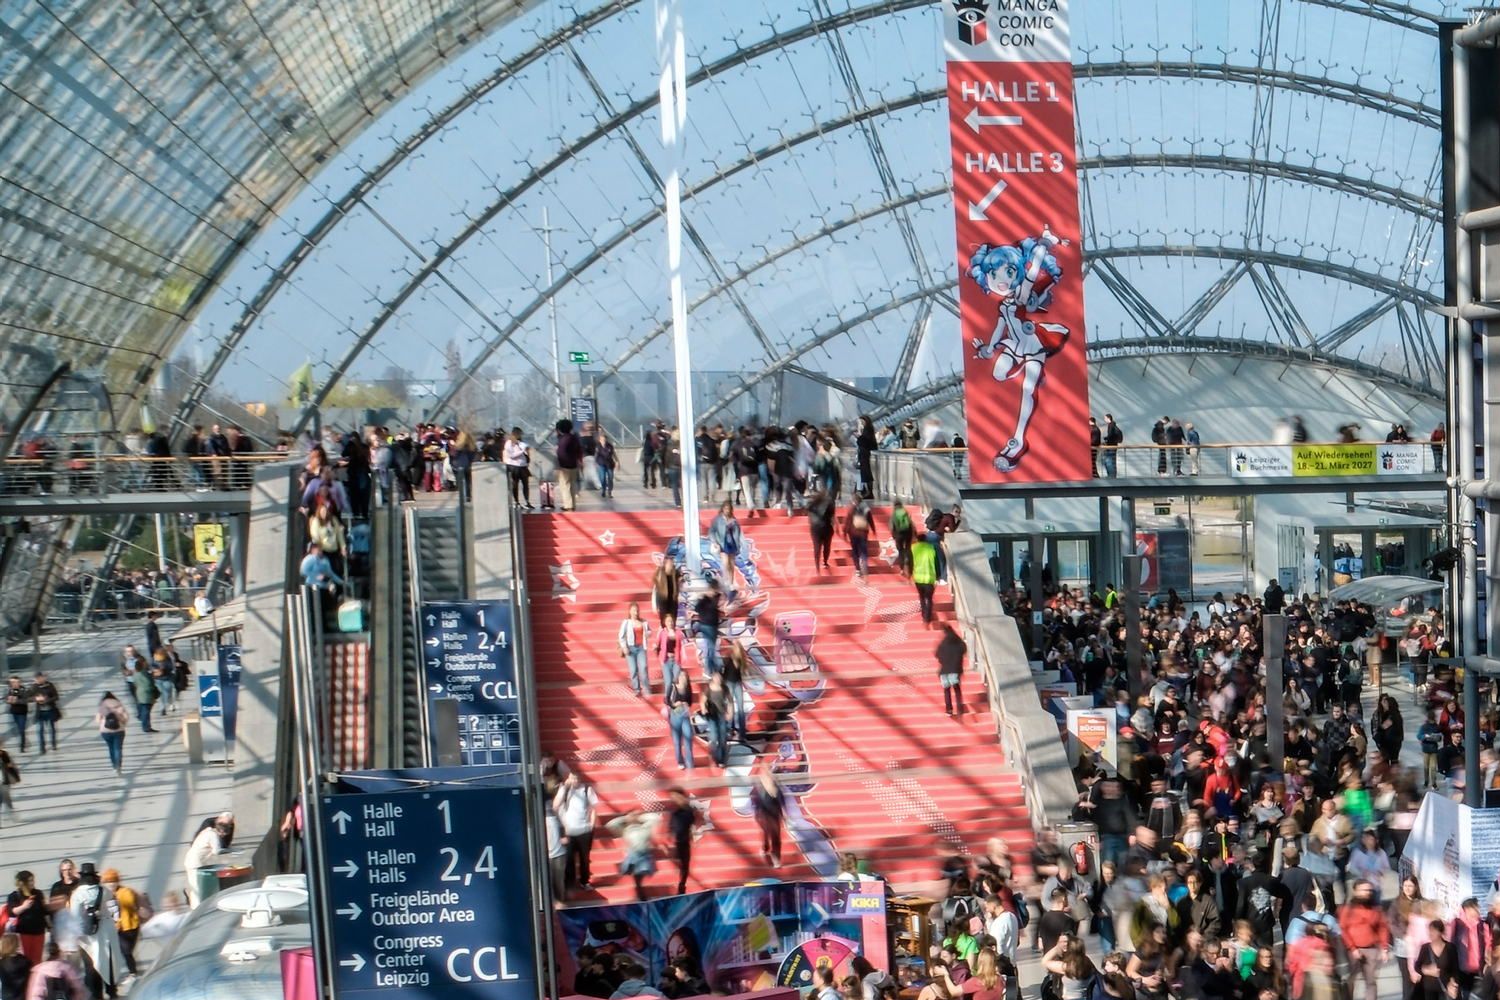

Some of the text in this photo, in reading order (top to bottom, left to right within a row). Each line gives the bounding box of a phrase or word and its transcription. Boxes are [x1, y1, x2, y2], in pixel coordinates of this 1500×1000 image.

[997, 0, 1059, 12] MANGA
[998, 15, 1054, 29] COMIC
[999, 33, 1035, 47] CON
[961, 81, 1060, 102] HALLE 1
[965, 151, 1064, 173] HALLE 3
[1250, 456, 1281, 464] Leipziger
[1297, 451, 1373, 459] Auf Wiedersehen!
[1329, 461, 1350, 470] März
[1352, 461, 1373, 469] 2027
[441, 610, 485, 628] Halle 1
[442, 620, 458, 628] Hall
[442, 631, 508, 651] Hallen 2,4
[443, 641, 464, 650] Halls
[444, 653, 488, 664] Freigelände
[444, 661, 496, 671] Outdoor Area
[446, 674, 481, 684] Congress
[446, 681, 518, 699] Center CCL
[363, 799, 452, 834] Halle 1
[365, 821, 396, 837] Hall
[367, 845, 498, 886] Hallen 2,4
[368, 867, 407, 884] Halls
[370, 889, 460, 911] Freigelände
[371, 908, 475, 927] Outdoor Area
[373, 935, 444, 952] Congress
[375, 946, 519, 983] Center CCL
[376, 971, 430, 988] Leipzig
